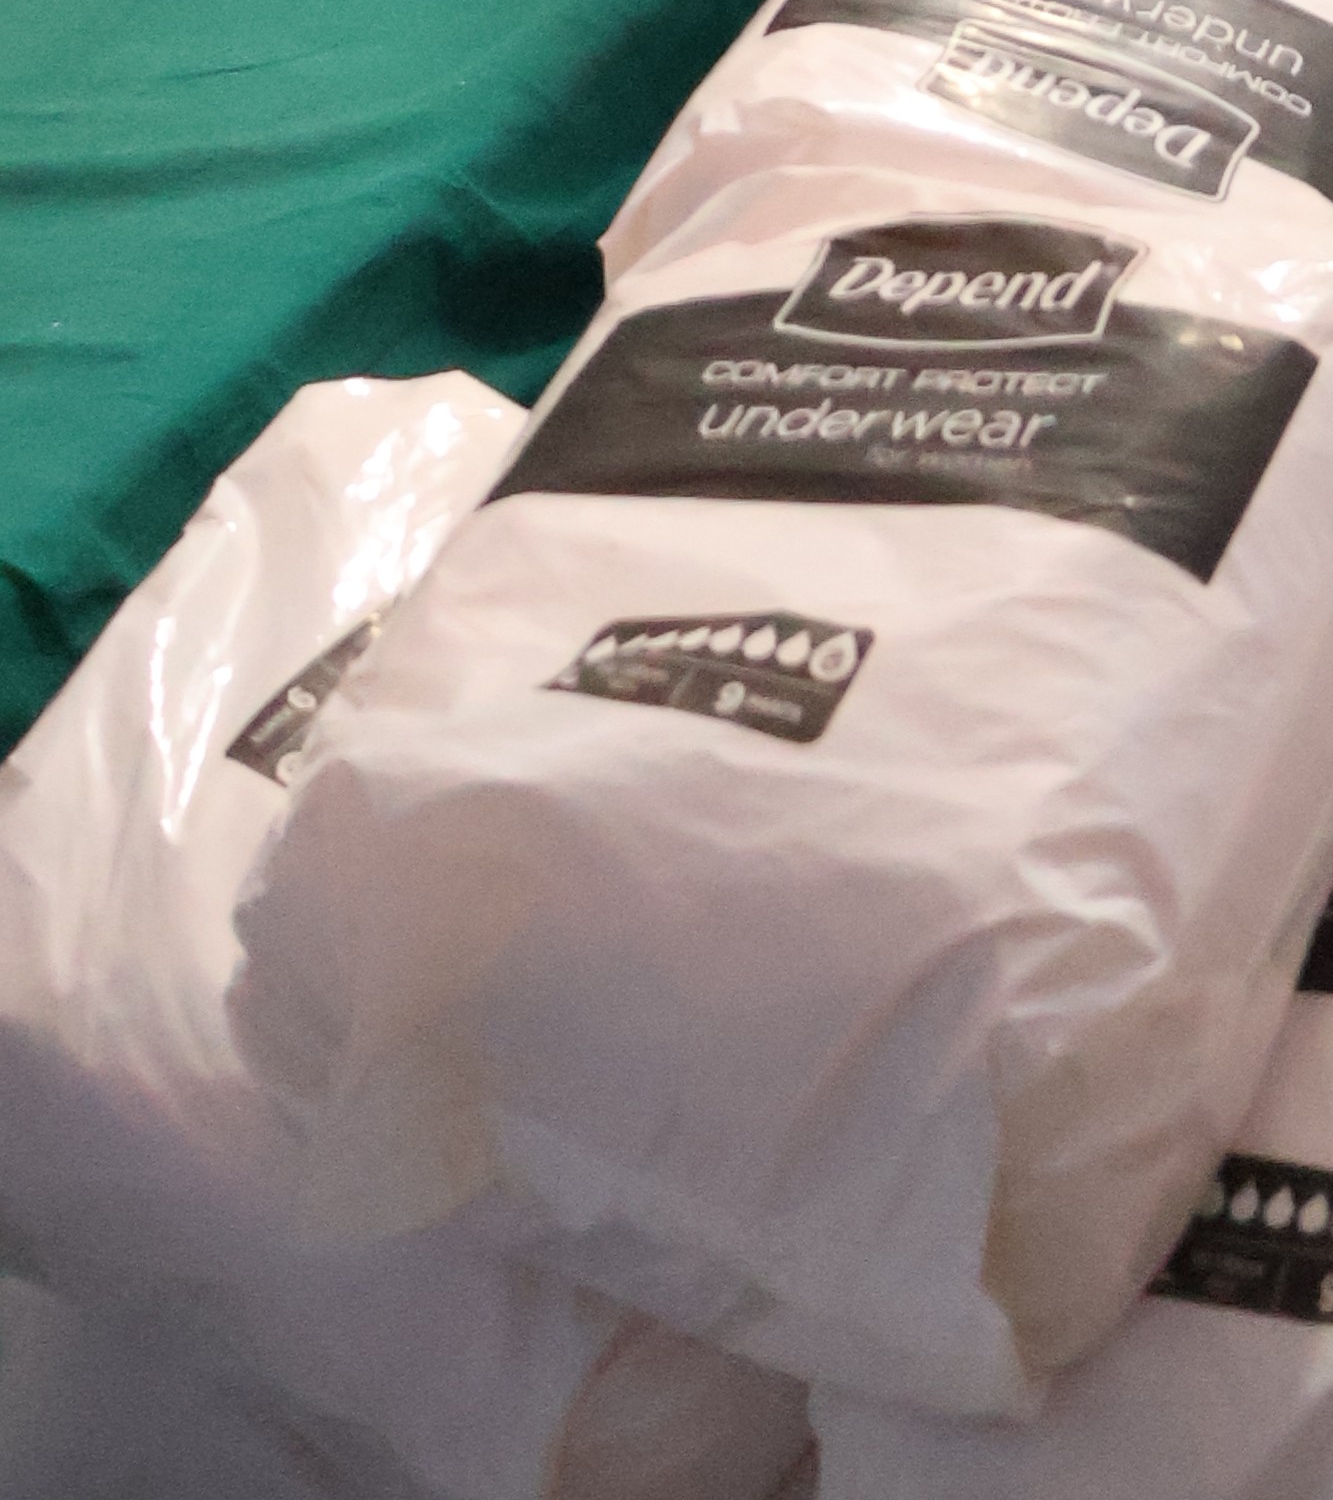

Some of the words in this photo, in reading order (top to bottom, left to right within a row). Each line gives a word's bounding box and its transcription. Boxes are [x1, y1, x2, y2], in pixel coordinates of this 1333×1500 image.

[829, 256, 1102, 316] Depend
[702, 360, 908, 391] COMFORT
[699, 399, 1057, 449] underwear
